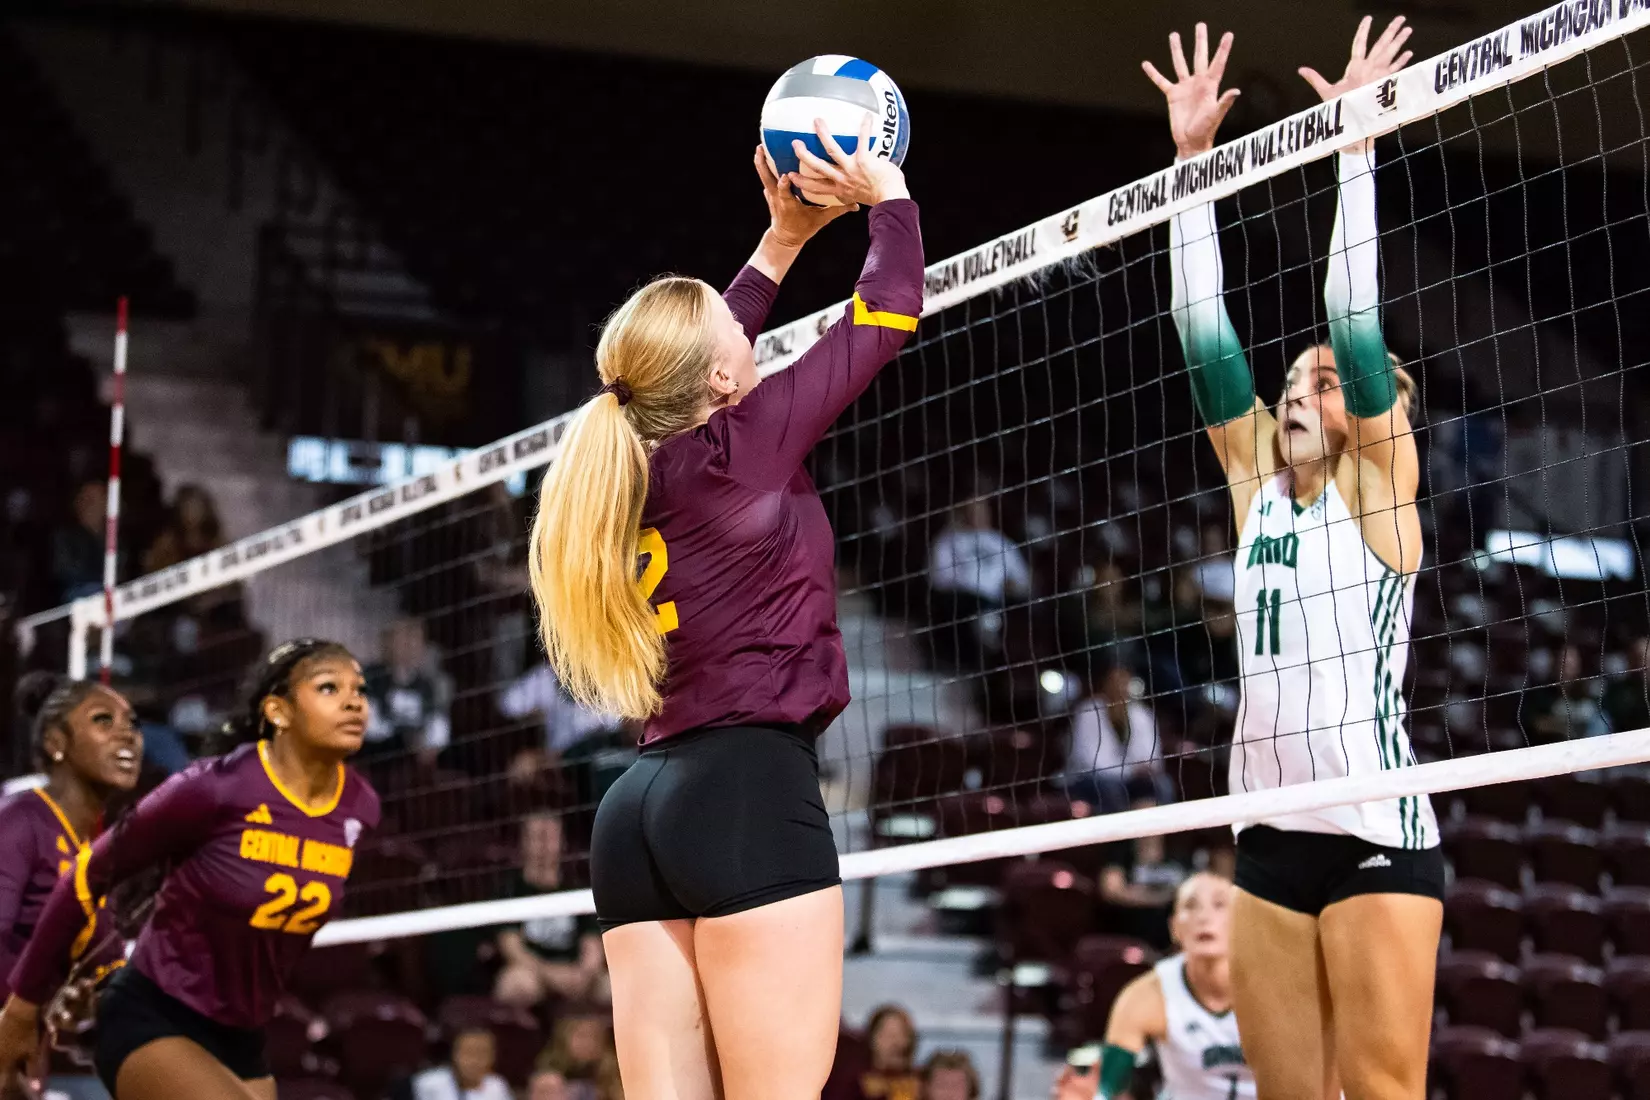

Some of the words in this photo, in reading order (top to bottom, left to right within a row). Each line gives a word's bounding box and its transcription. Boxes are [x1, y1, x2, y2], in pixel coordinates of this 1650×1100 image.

[1434, 29, 1513, 95] CENTRAL
[1519, 0, 1613, 60] MICHIGAN
[1107, 172, 1168, 227] CENTRAL
[1172, 139, 1246, 202] MICHIGAN
[1250, 98, 1345, 168] VOLLEYBALL
[1255, 588, 1281, 656] 11
[249, 872, 332, 935] 22
